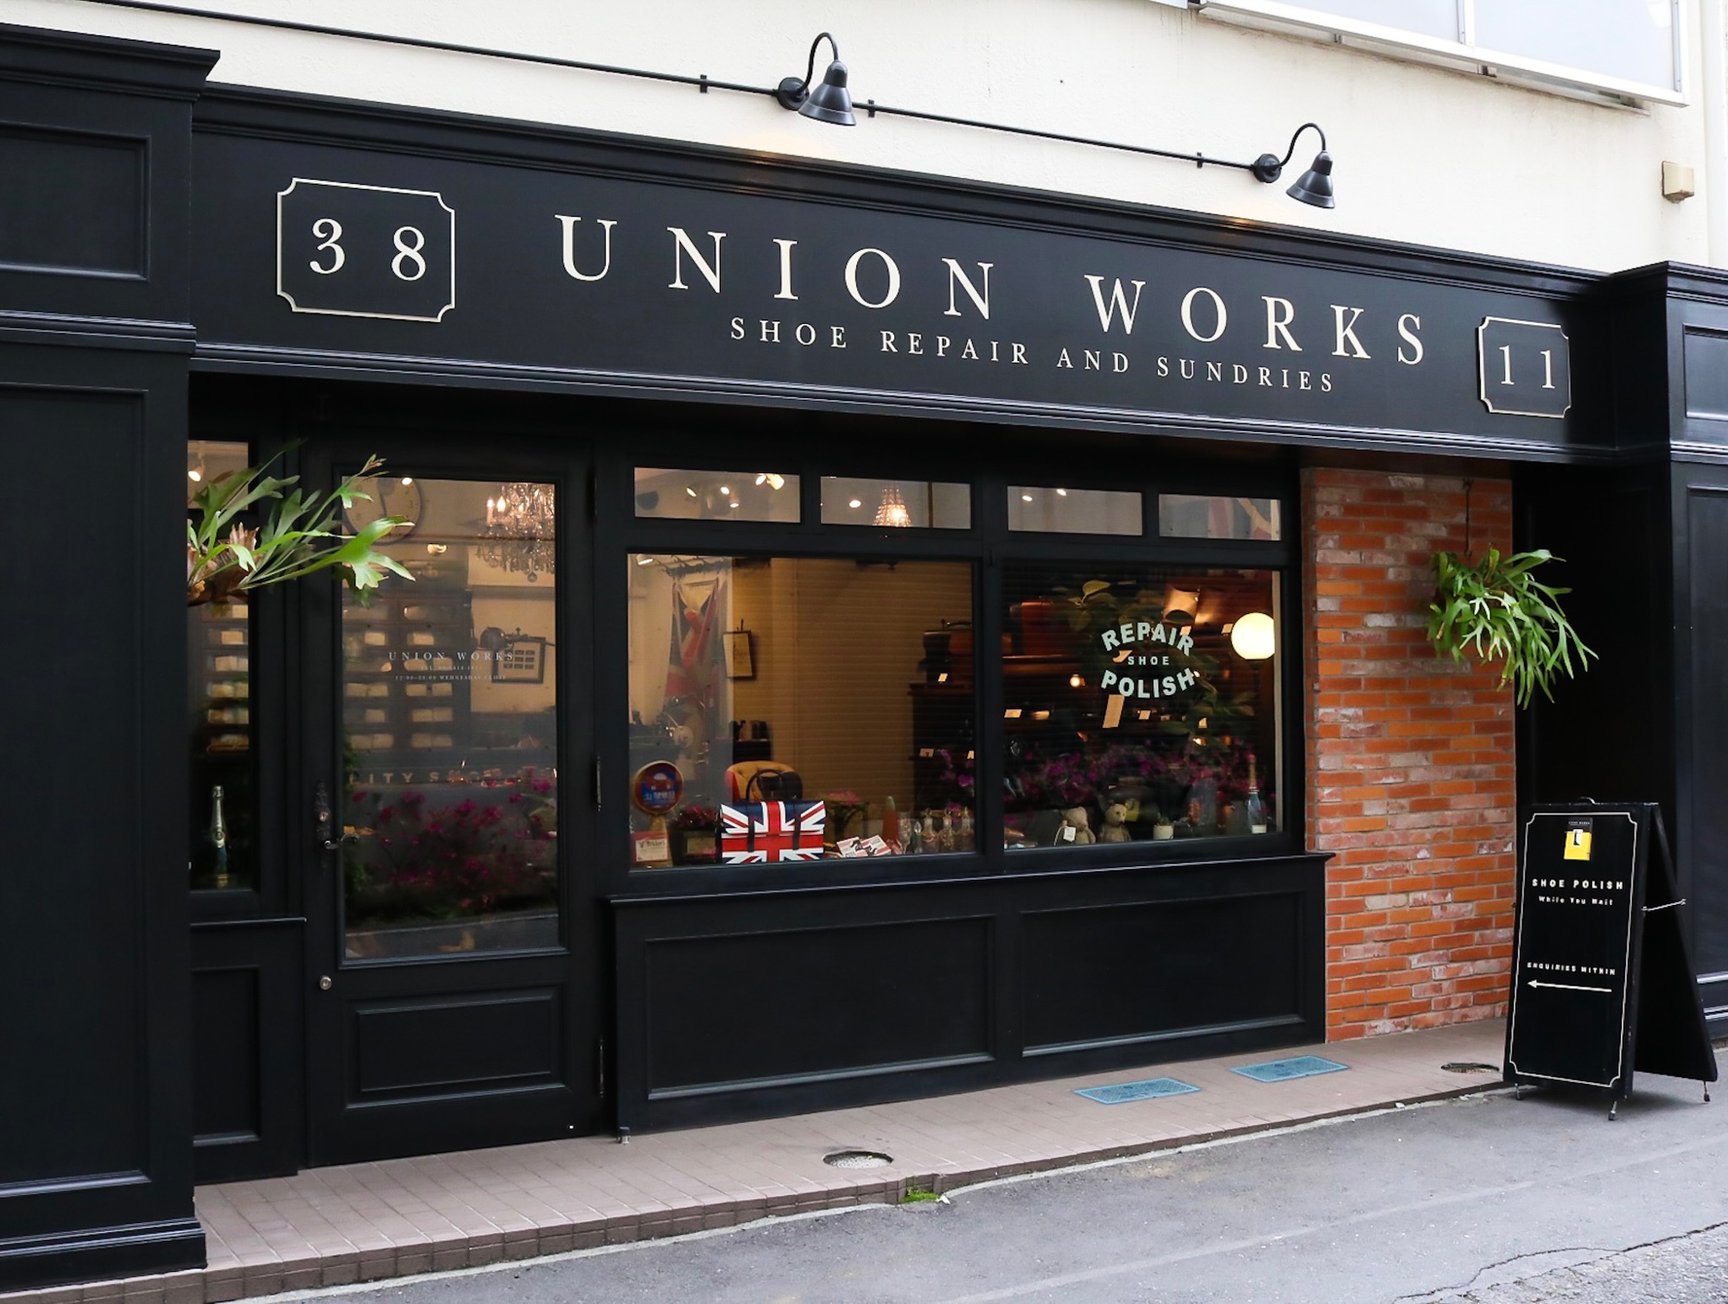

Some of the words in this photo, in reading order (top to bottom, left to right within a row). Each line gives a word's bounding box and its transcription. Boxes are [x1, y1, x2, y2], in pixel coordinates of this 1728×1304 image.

[554, 214, 994, 321] UNION
[1084, 274, 1425, 365] WORKS
[730, 317, 848, 348] SHOE
[880, 330, 1029, 365] REPAIR
[1056, 347, 1130, 374] AND
[1157, 356, 1333, 393] SUNDRIES
[1101, 622, 1194, 656] REPAIR
[388, 651, 445, 661] UNION
[457, 651, 513, 661] WORKS
[1127, 656, 1170, 666] SHOE
[1101, 667, 1195, 699] POLISH
[1532, 878, 1565, 888] SHOE
[1573, 879, 1623, 890] POLISH
[1538, 895, 1565, 904] While
[1569, 897, 1586, 905] You
[1592, 898, 1613, 906] Wait
[1581, 966, 1616, 976] WITHIN
